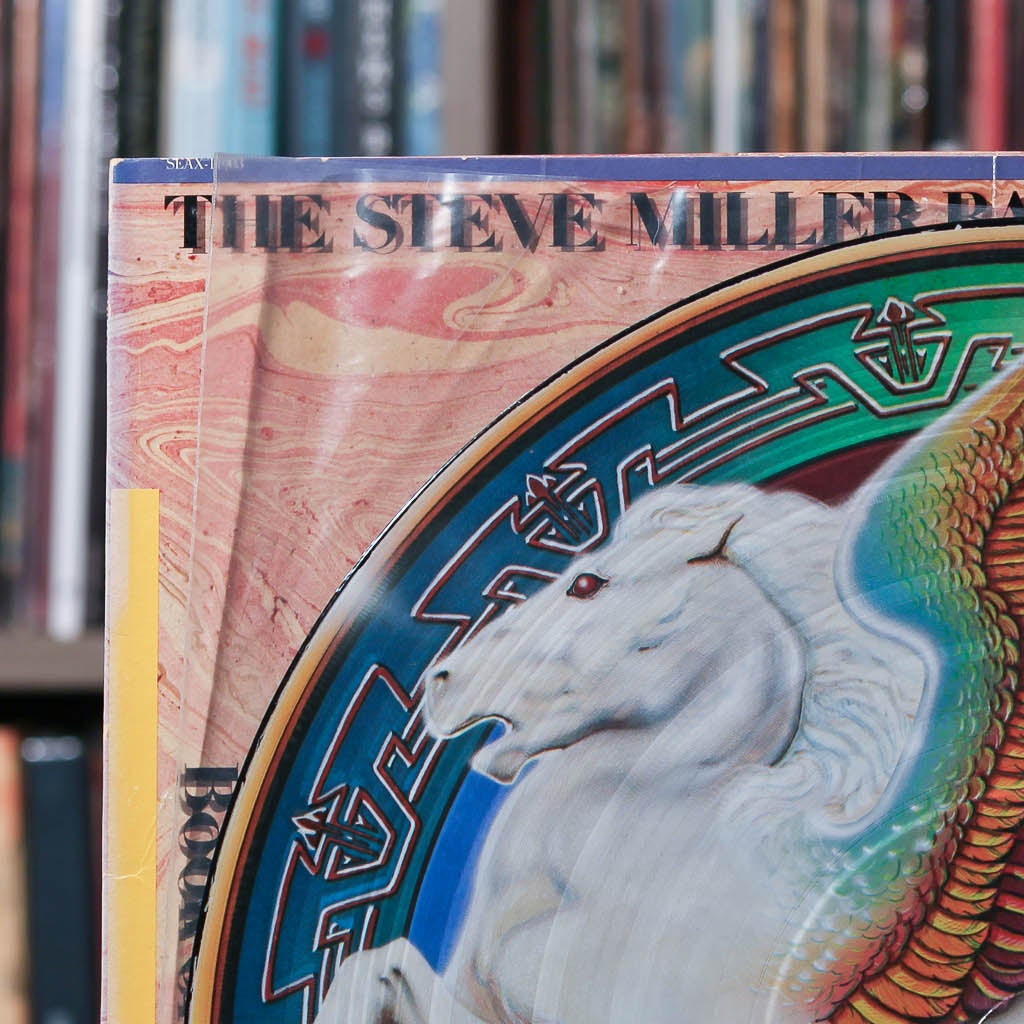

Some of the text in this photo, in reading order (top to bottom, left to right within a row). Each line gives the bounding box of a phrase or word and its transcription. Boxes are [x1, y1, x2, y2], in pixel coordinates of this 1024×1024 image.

[164, 194, 334, 253] THE
[353, 193, 605, 253] STEVE
[627, 191, 922, 250] MILLER
